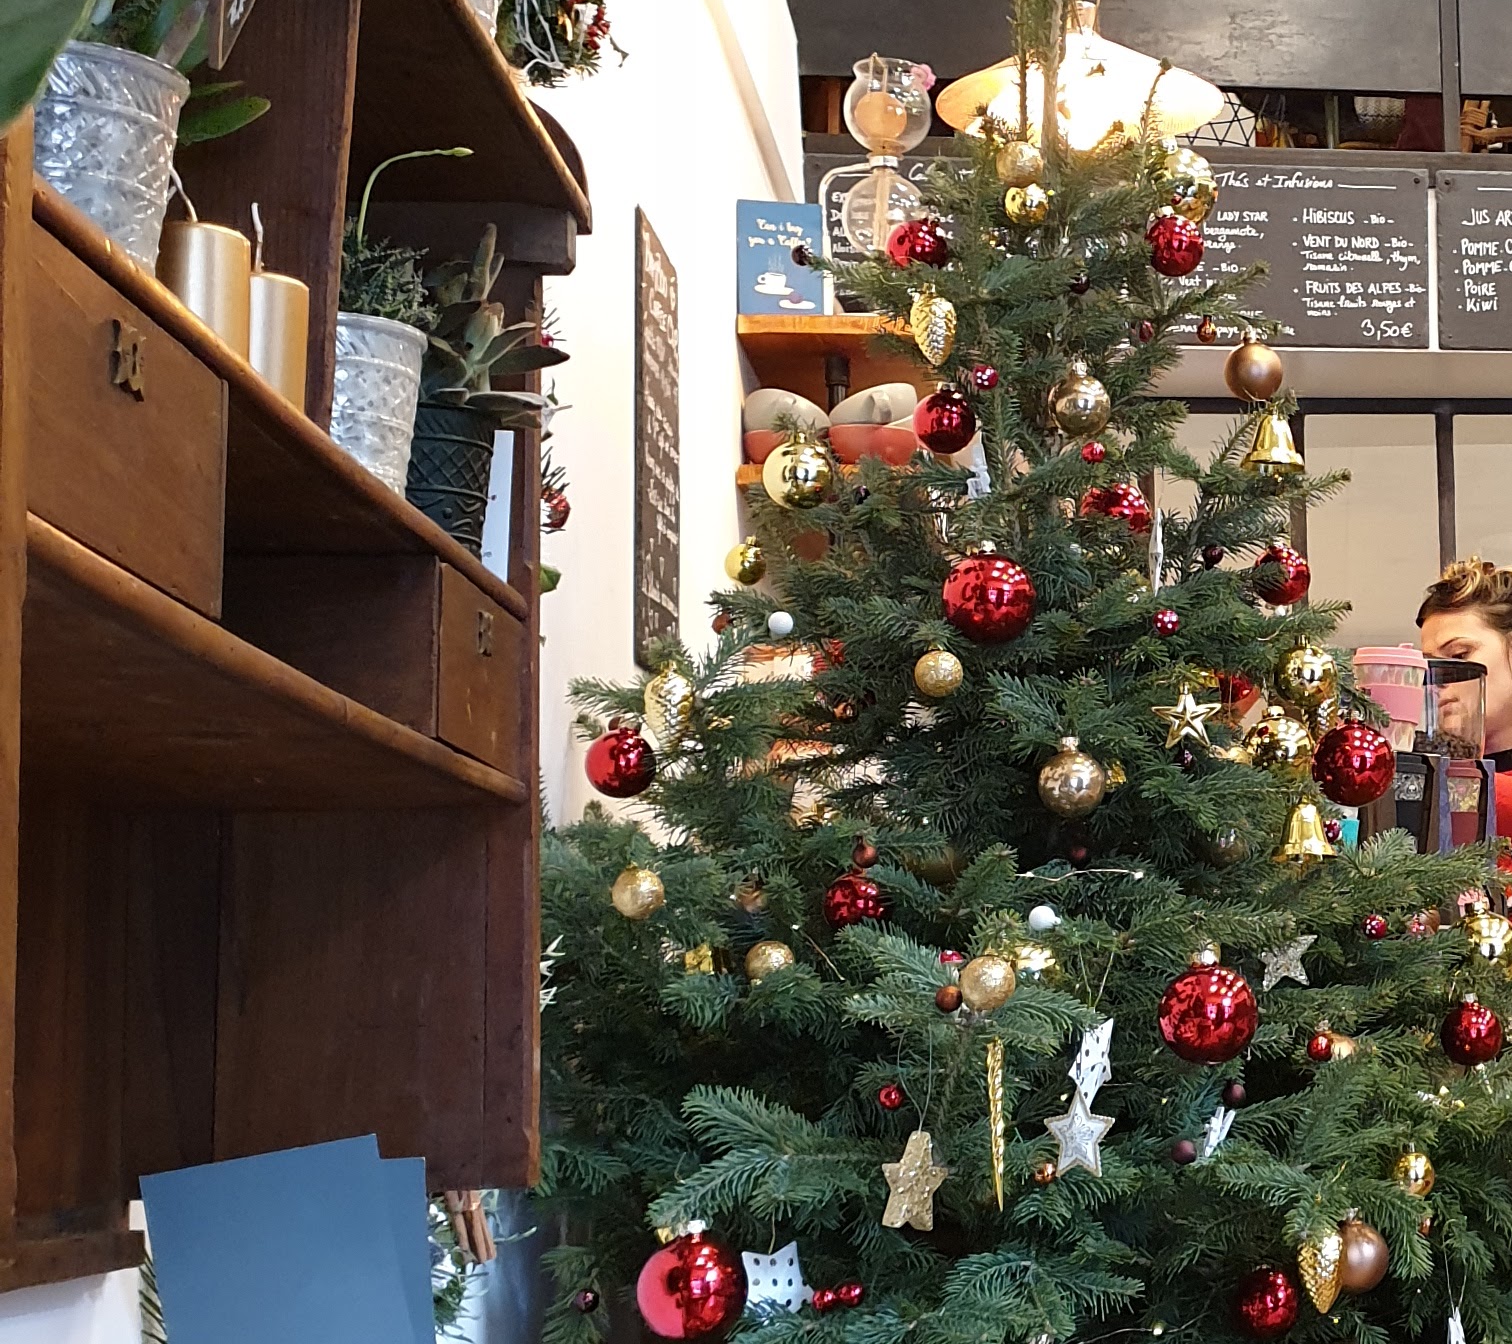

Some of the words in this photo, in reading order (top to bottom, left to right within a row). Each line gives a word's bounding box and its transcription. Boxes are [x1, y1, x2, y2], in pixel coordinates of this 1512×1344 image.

[1215, 171, 1249, 188] Thés
[1255, 174, 1272, 187] et
[1272, 172, 1333, 190] Infusions
[1217, 211, 1240, 222] LADY
[1243, 211, 1268, 222] STAR
[1462, 208, 1490, 226] JUS
[1302, 233, 1332, 248] VENT
[1334, 235, 1348, 248] DU
[1351, 236, 1380, 249] NORD
[1305, 279, 1341, 294] FRUITS
[1345, 282, 1364, 294] DES
[1368, 282, 1402, 295] ALPES
[1404, 297, 1416, 308] et
[1361, 319, 1413, 341] 3,50€
